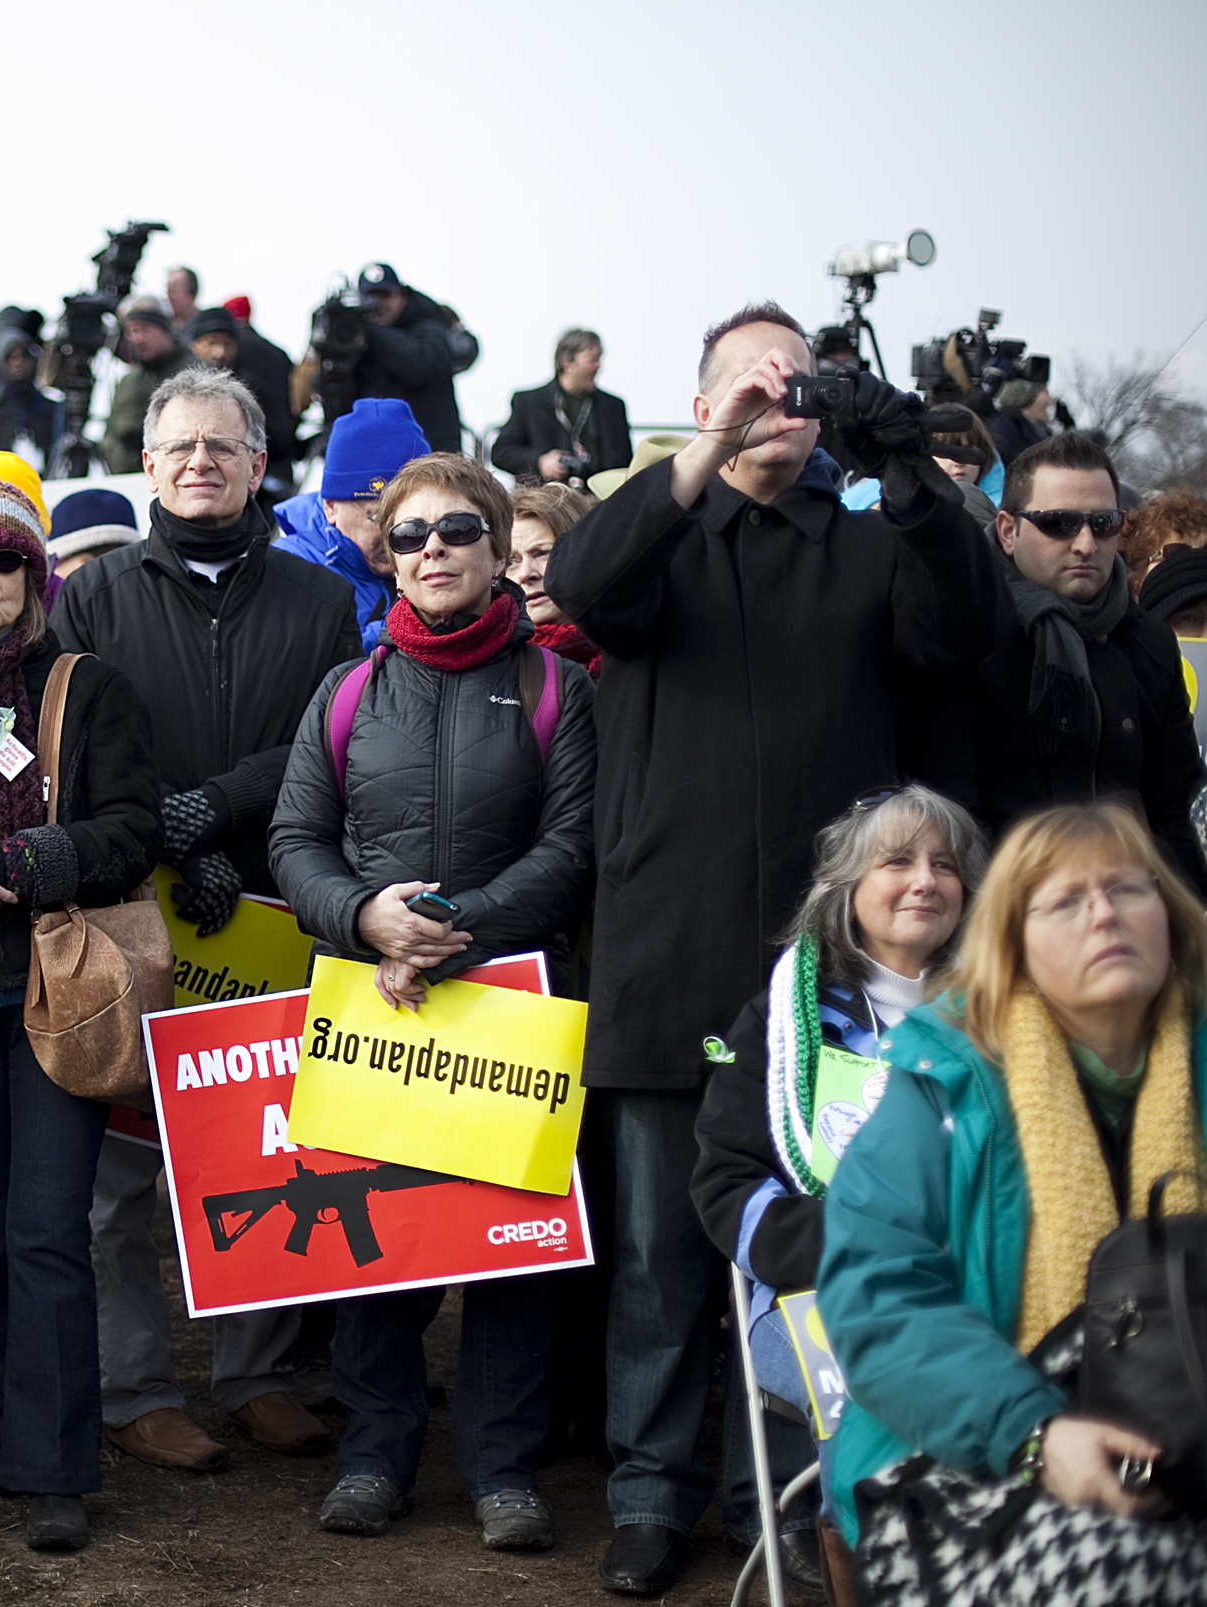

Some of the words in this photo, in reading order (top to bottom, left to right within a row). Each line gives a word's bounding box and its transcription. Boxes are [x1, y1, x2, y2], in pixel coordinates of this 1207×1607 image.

[176, 1035, 304, 1091] ANOTH
[308, 1017, 570, 1114] demandaplan.org
[487, 1217, 567, 1245] CREDO
[537, 1237, 567, 1248] action
